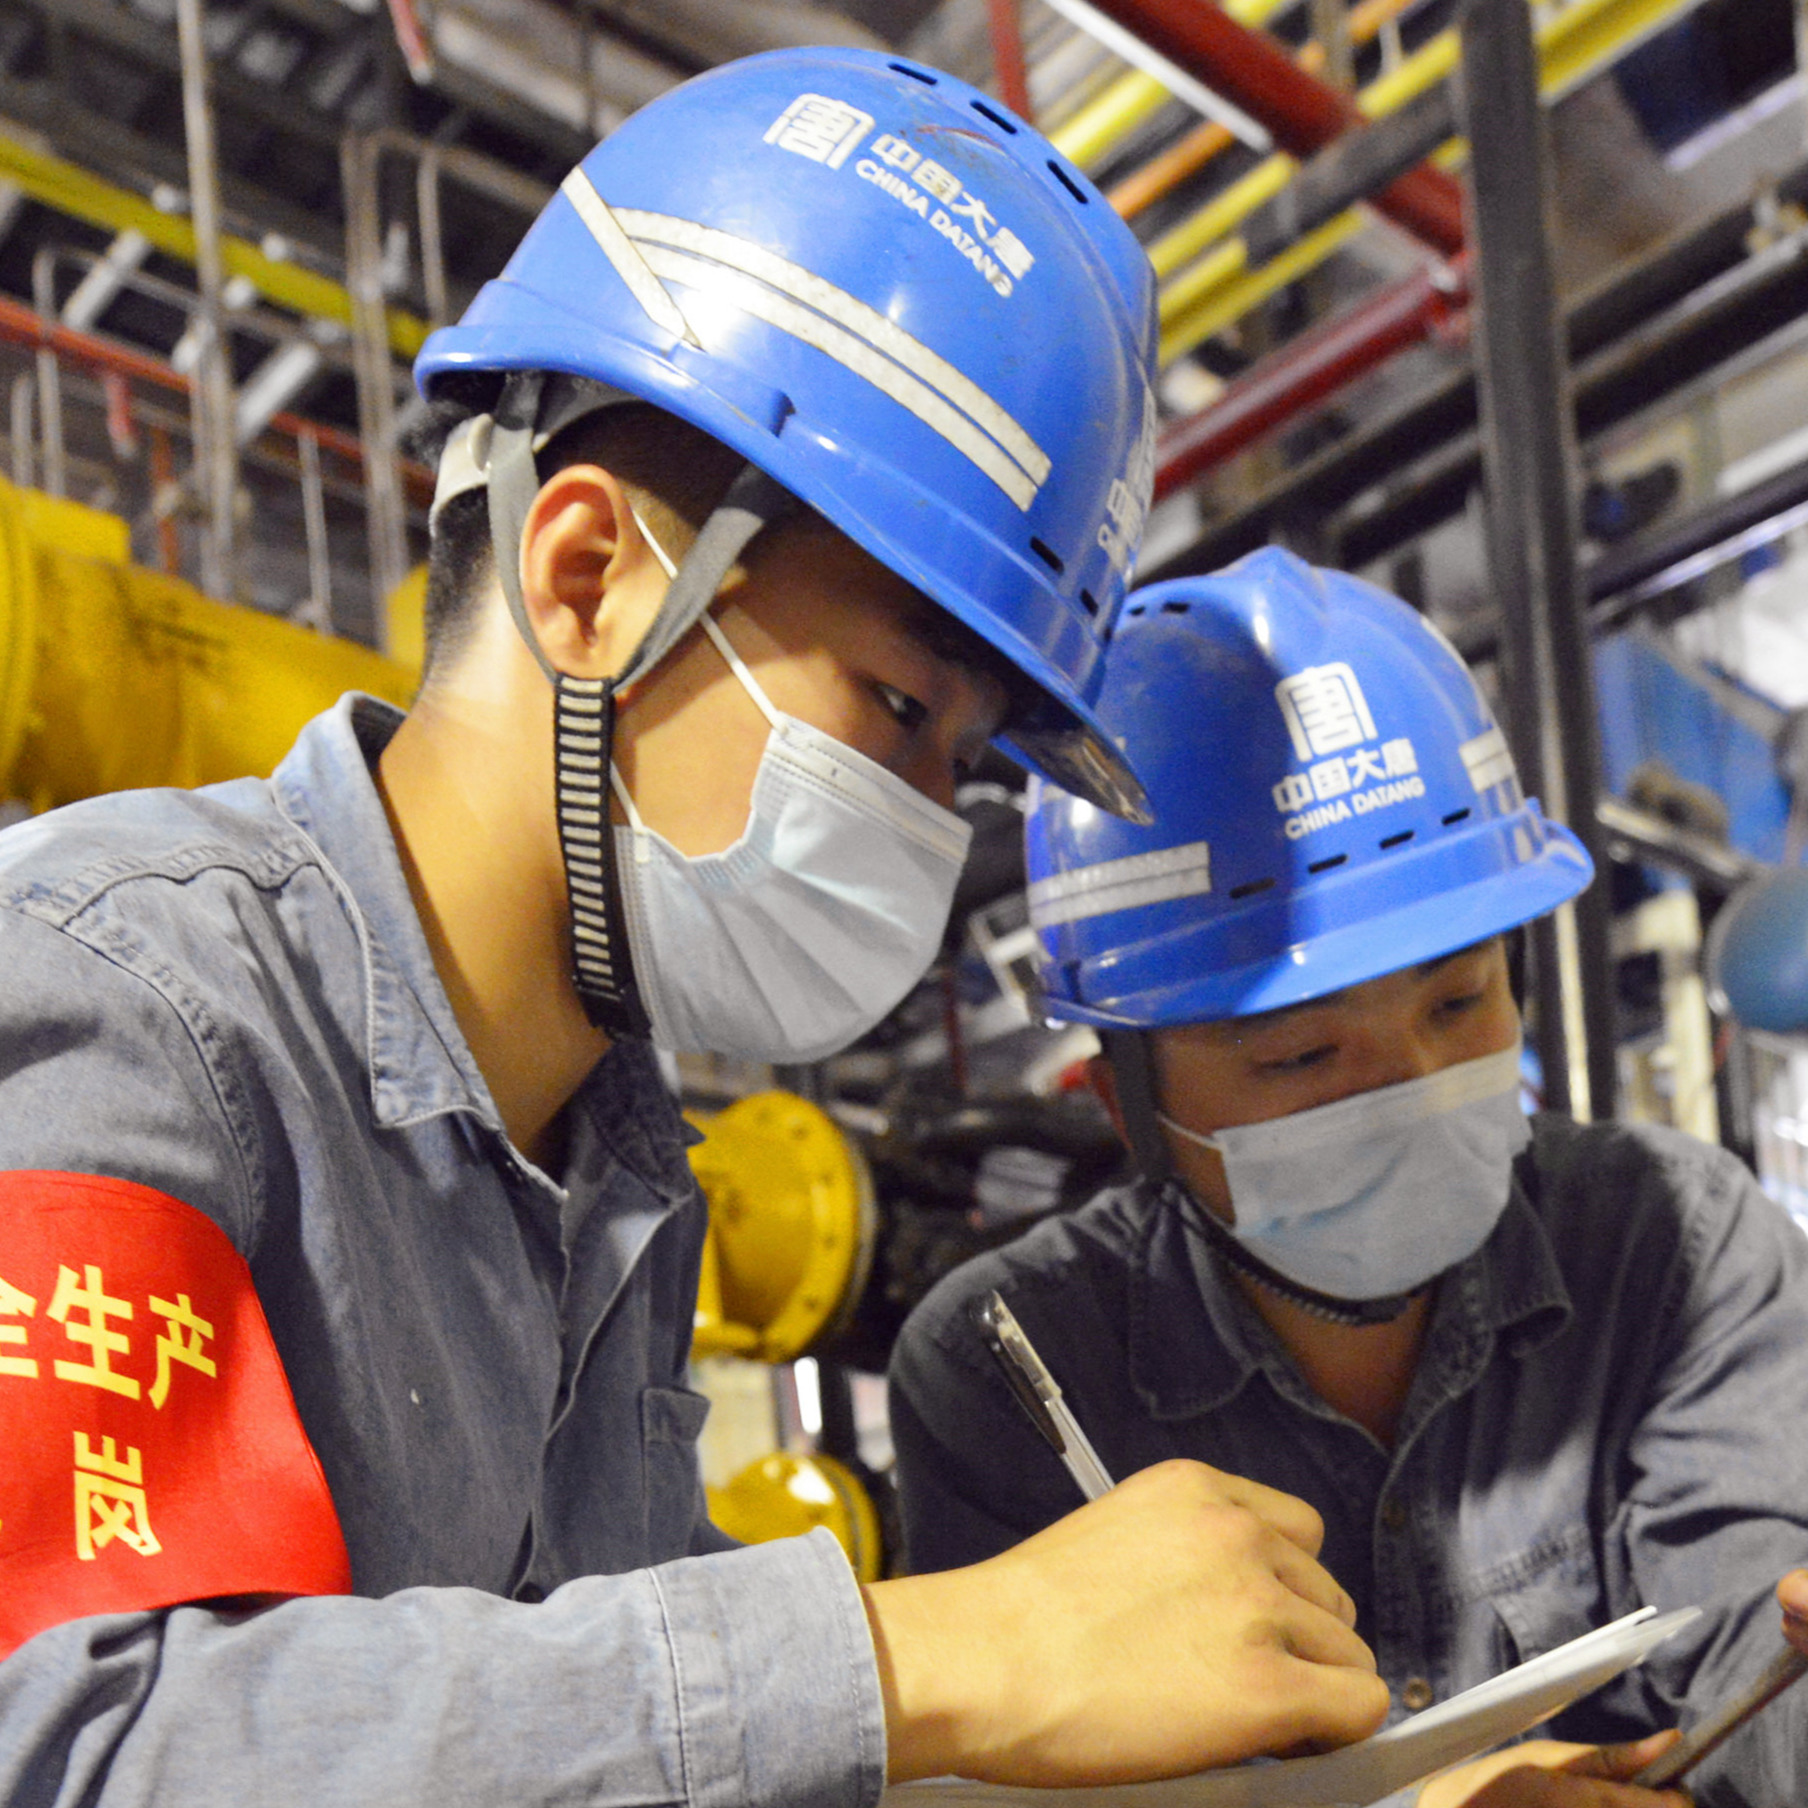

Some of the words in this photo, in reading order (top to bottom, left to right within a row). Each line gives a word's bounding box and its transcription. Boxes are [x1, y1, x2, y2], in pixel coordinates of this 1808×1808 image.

[855, 158, 930, 219] CHINA
[928, 208, 1013, 298] DATANG
[1284, 799, 1353, 840] CHINA
[1351, 775, 1426, 816] DATANG
